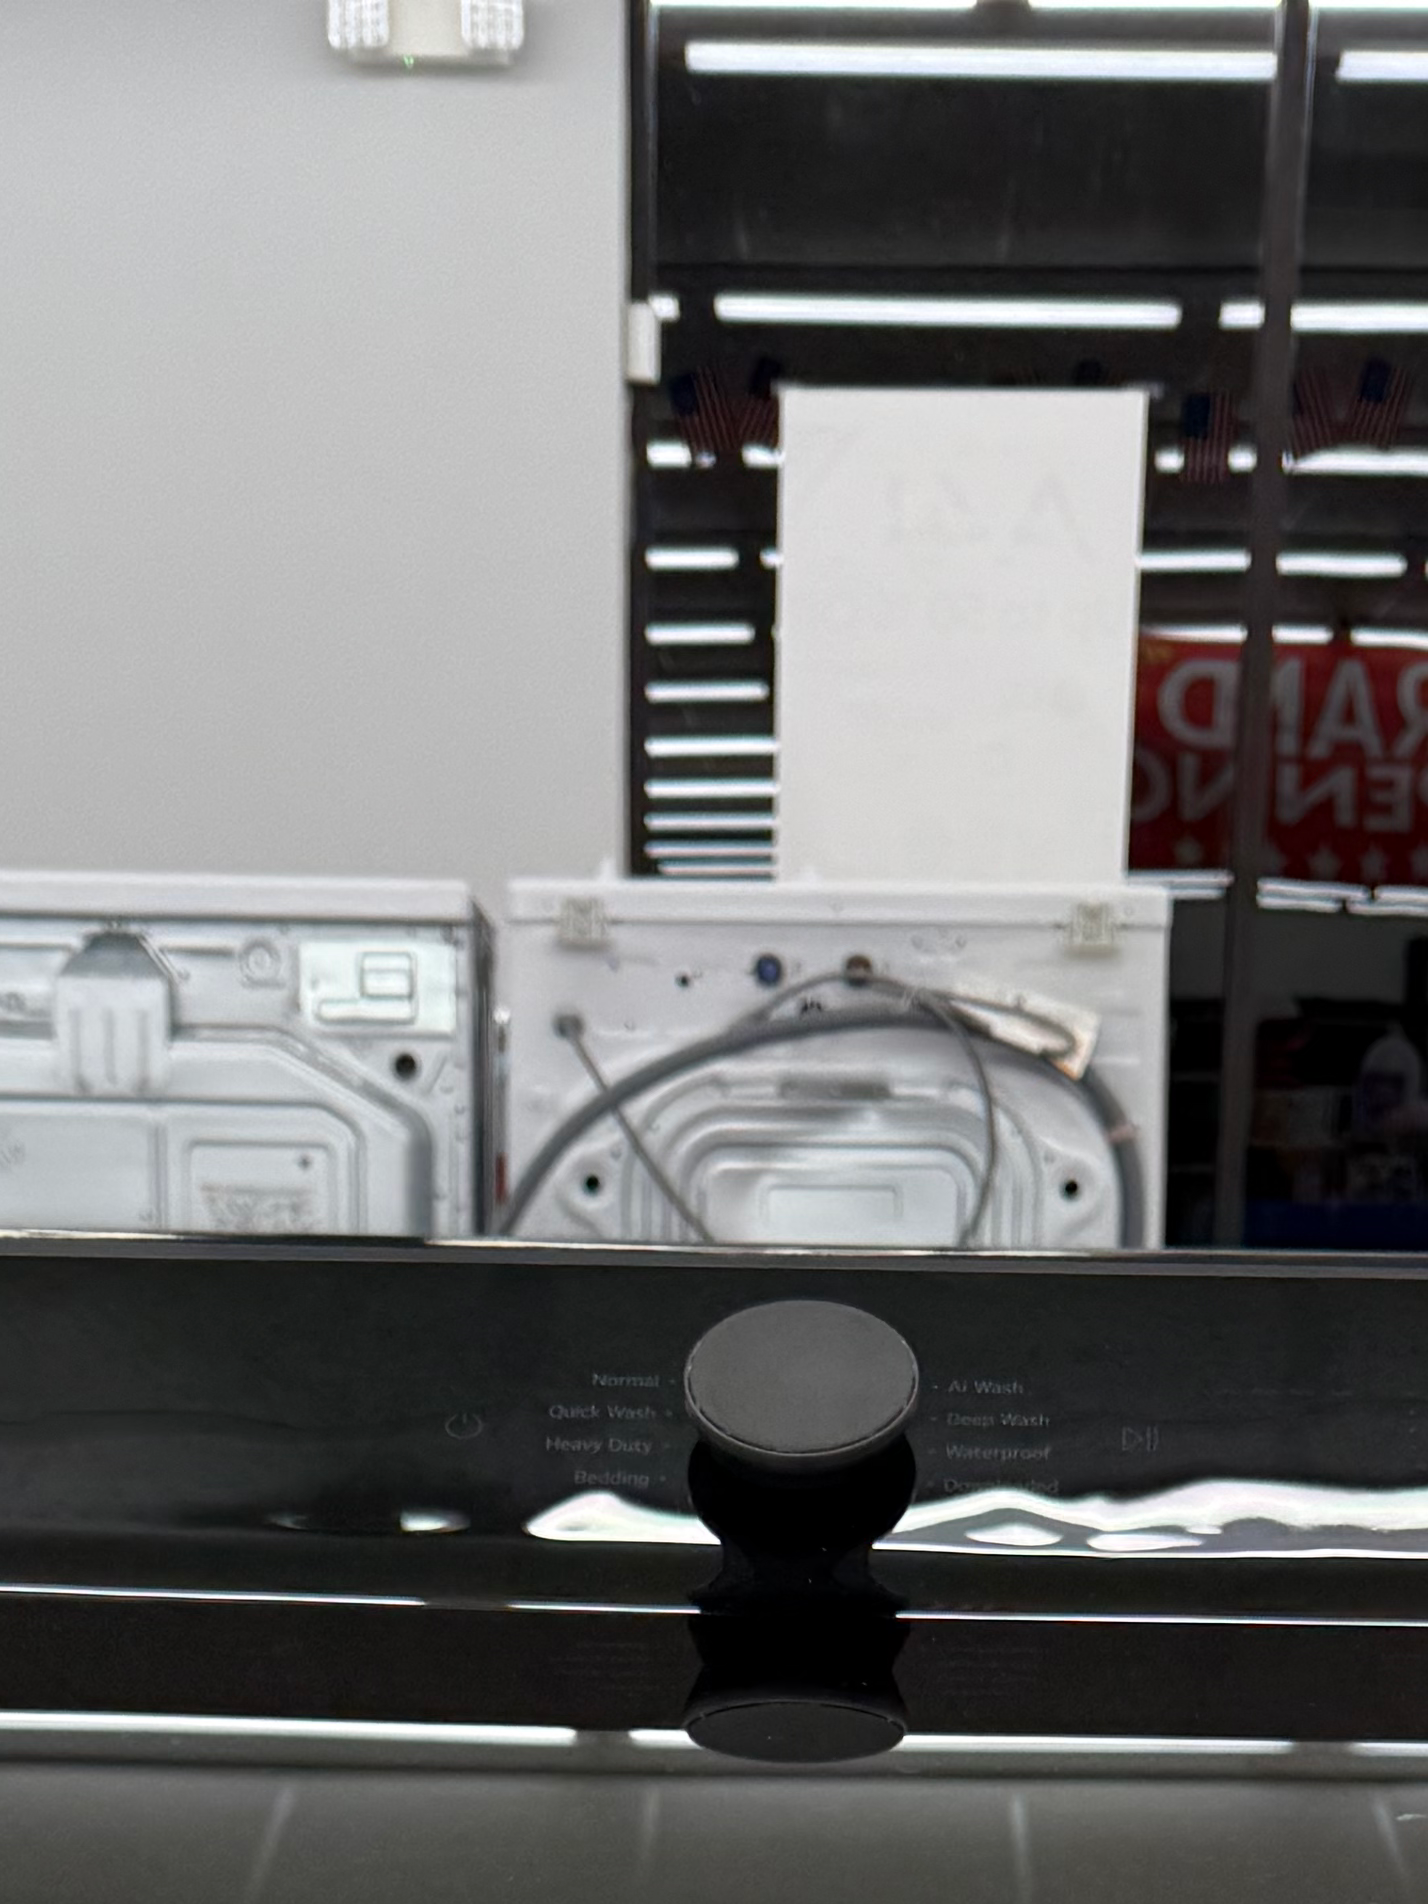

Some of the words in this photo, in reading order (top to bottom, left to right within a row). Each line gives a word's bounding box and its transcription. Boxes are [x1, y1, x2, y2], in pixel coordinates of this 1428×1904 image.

[592, 1373, 660, 1388] Normal
[974, 1380, 1024, 1394] Wash
[549, 1404, 601, 1419] Quick
[606, 1404, 657, 1420] Wash
[946, 1412, 995, 1428] Deep
[1000, 1412, 1051, 1428] Wash
[545, 1436, 603, 1454] Heavy
[608, 1437, 653, 1455] Duty
[945, 1442, 1053, 1462] Waterproof
[574, 1470, 650, 1488] Bedding
